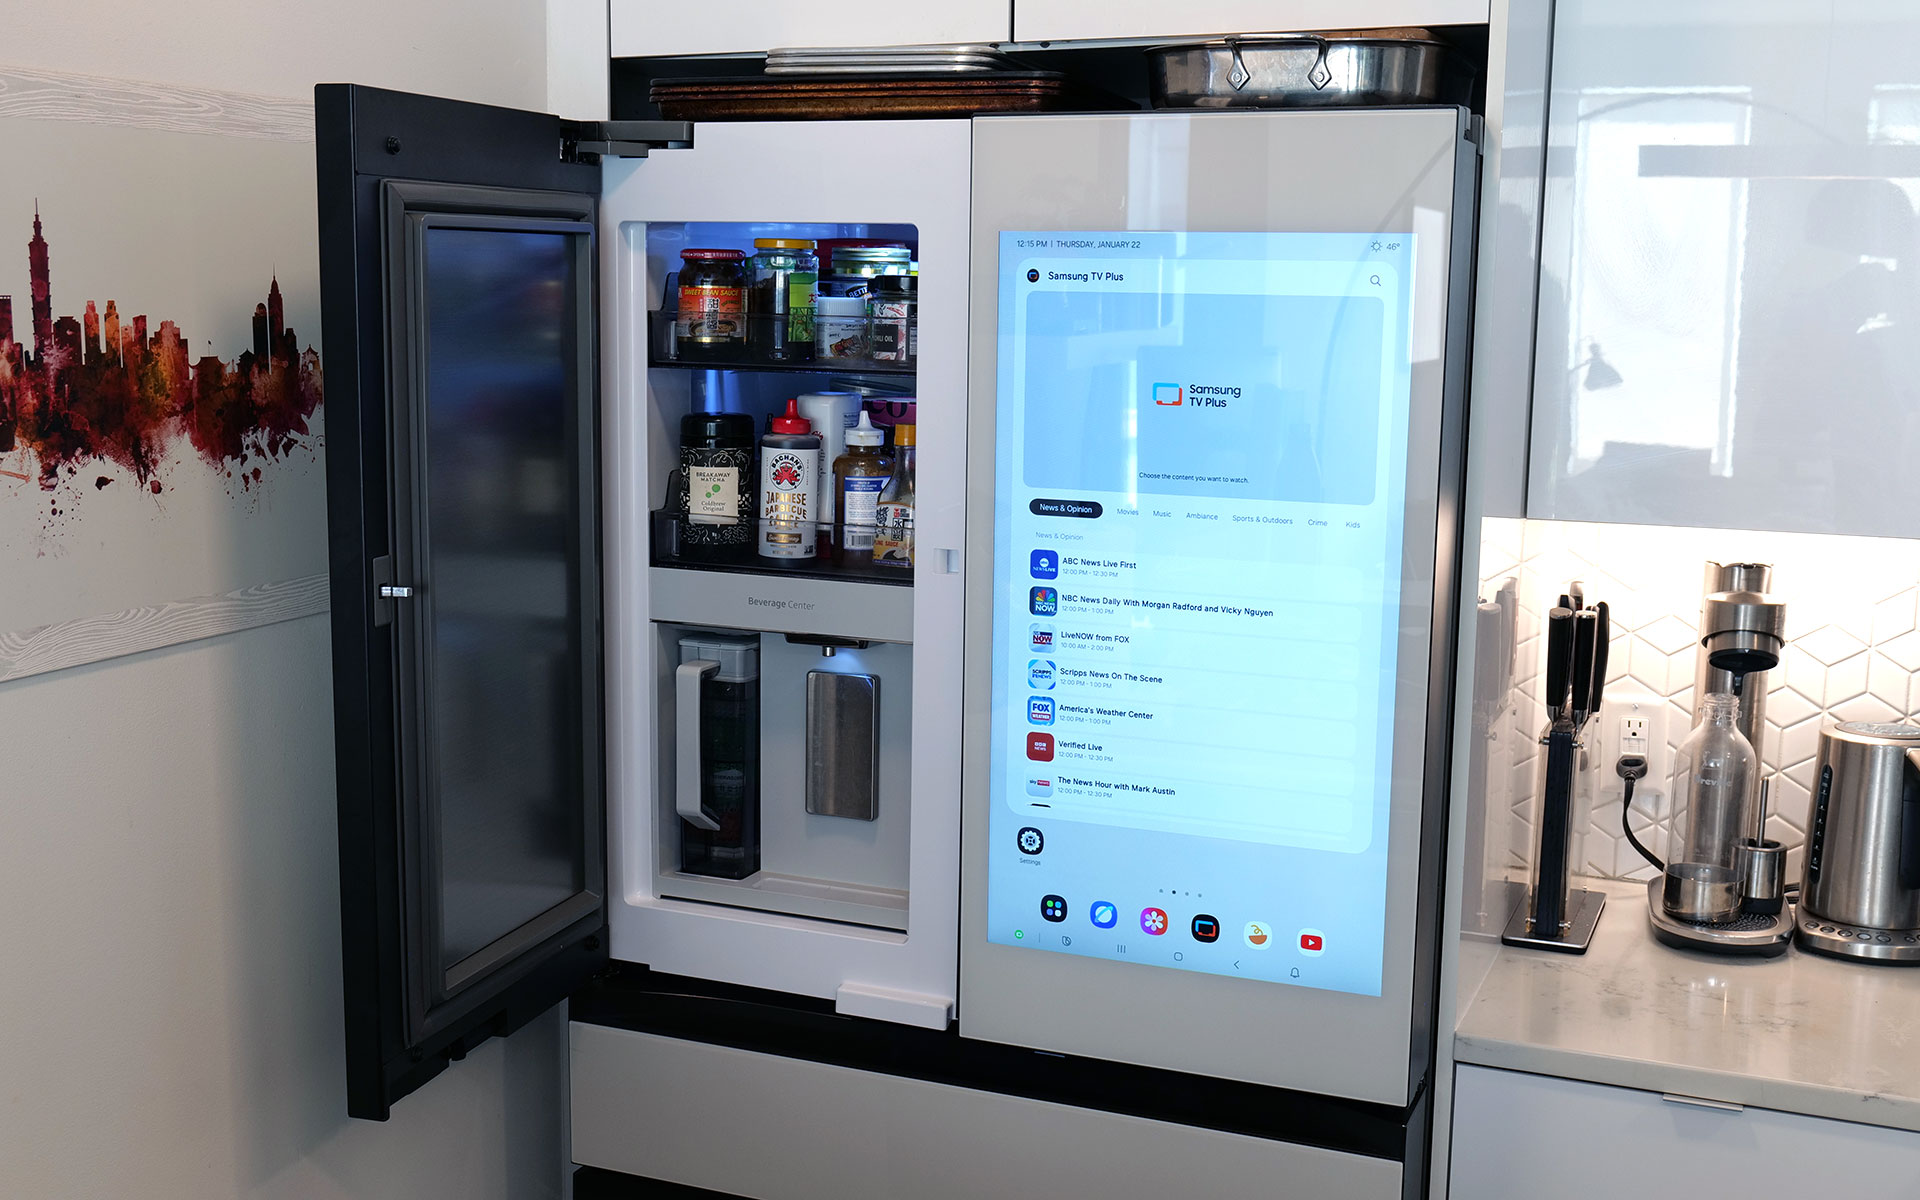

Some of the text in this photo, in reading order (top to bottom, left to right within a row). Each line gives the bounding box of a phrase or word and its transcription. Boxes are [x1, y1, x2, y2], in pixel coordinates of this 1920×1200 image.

[1017, 240, 1034, 248] 12:15
[1036, 240, 1048, 248] PM
[1056, 240, 1096, 248] THURSDAY,
[1048, 271, 1124, 282] Samsung TV Plus
[1189, 384, 1242, 398] Samsung
[1189, 397, 1227, 408] TV Plus
[1139, 472, 1160, 480] Choose
[766, 491, 807, 506] JAPANESE
[766, 504, 808, 520] BARBECUE
[1040, 504, 1092, 514] News & Opinion
[1117, 508, 1139, 516] Movies
[1152, 510, 1172, 518] Music
[1186, 512, 1218, 520] Ambiance
[1232, 515, 1254, 523] Sports
[1262, 516, 1293, 524] Outdoors
[1060, 533, 1084, 541] Opinion
[1062, 557, 1136, 569] ABC News Live First
[748, 596, 816, 610] Beverage Center
[1036, 604, 1054, 612] NOW
[1062, 594, 1078, 602] NBC
[1080, 596, 1100, 604] News
[1102, 597, 1120, 606] Daily
[1123, 599, 1140, 607] With
[1142, 600, 1170, 610] Morgan
[1172, 602, 1202, 612] Radford
[1221, 606, 1242, 615] Vicky
[1244, 608, 1274, 618] Nguyen
[1033, 634, 1052, 643] NOW
[1061, 632, 1094, 640] LiveNOW
[1096, 633, 1112, 642] from
[1060, 668, 1162, 684] Scripps News On The Scene
[1032, 702, 1050, 712] FOX
[1059, 704, 1154, 720] America's Weather Center
[1058, 740, 1102, 751] Verified Live
[1058, 776, 1176, 796] The News Hour with Mark Austin
[1020, 858, 1040, 866] Settings
